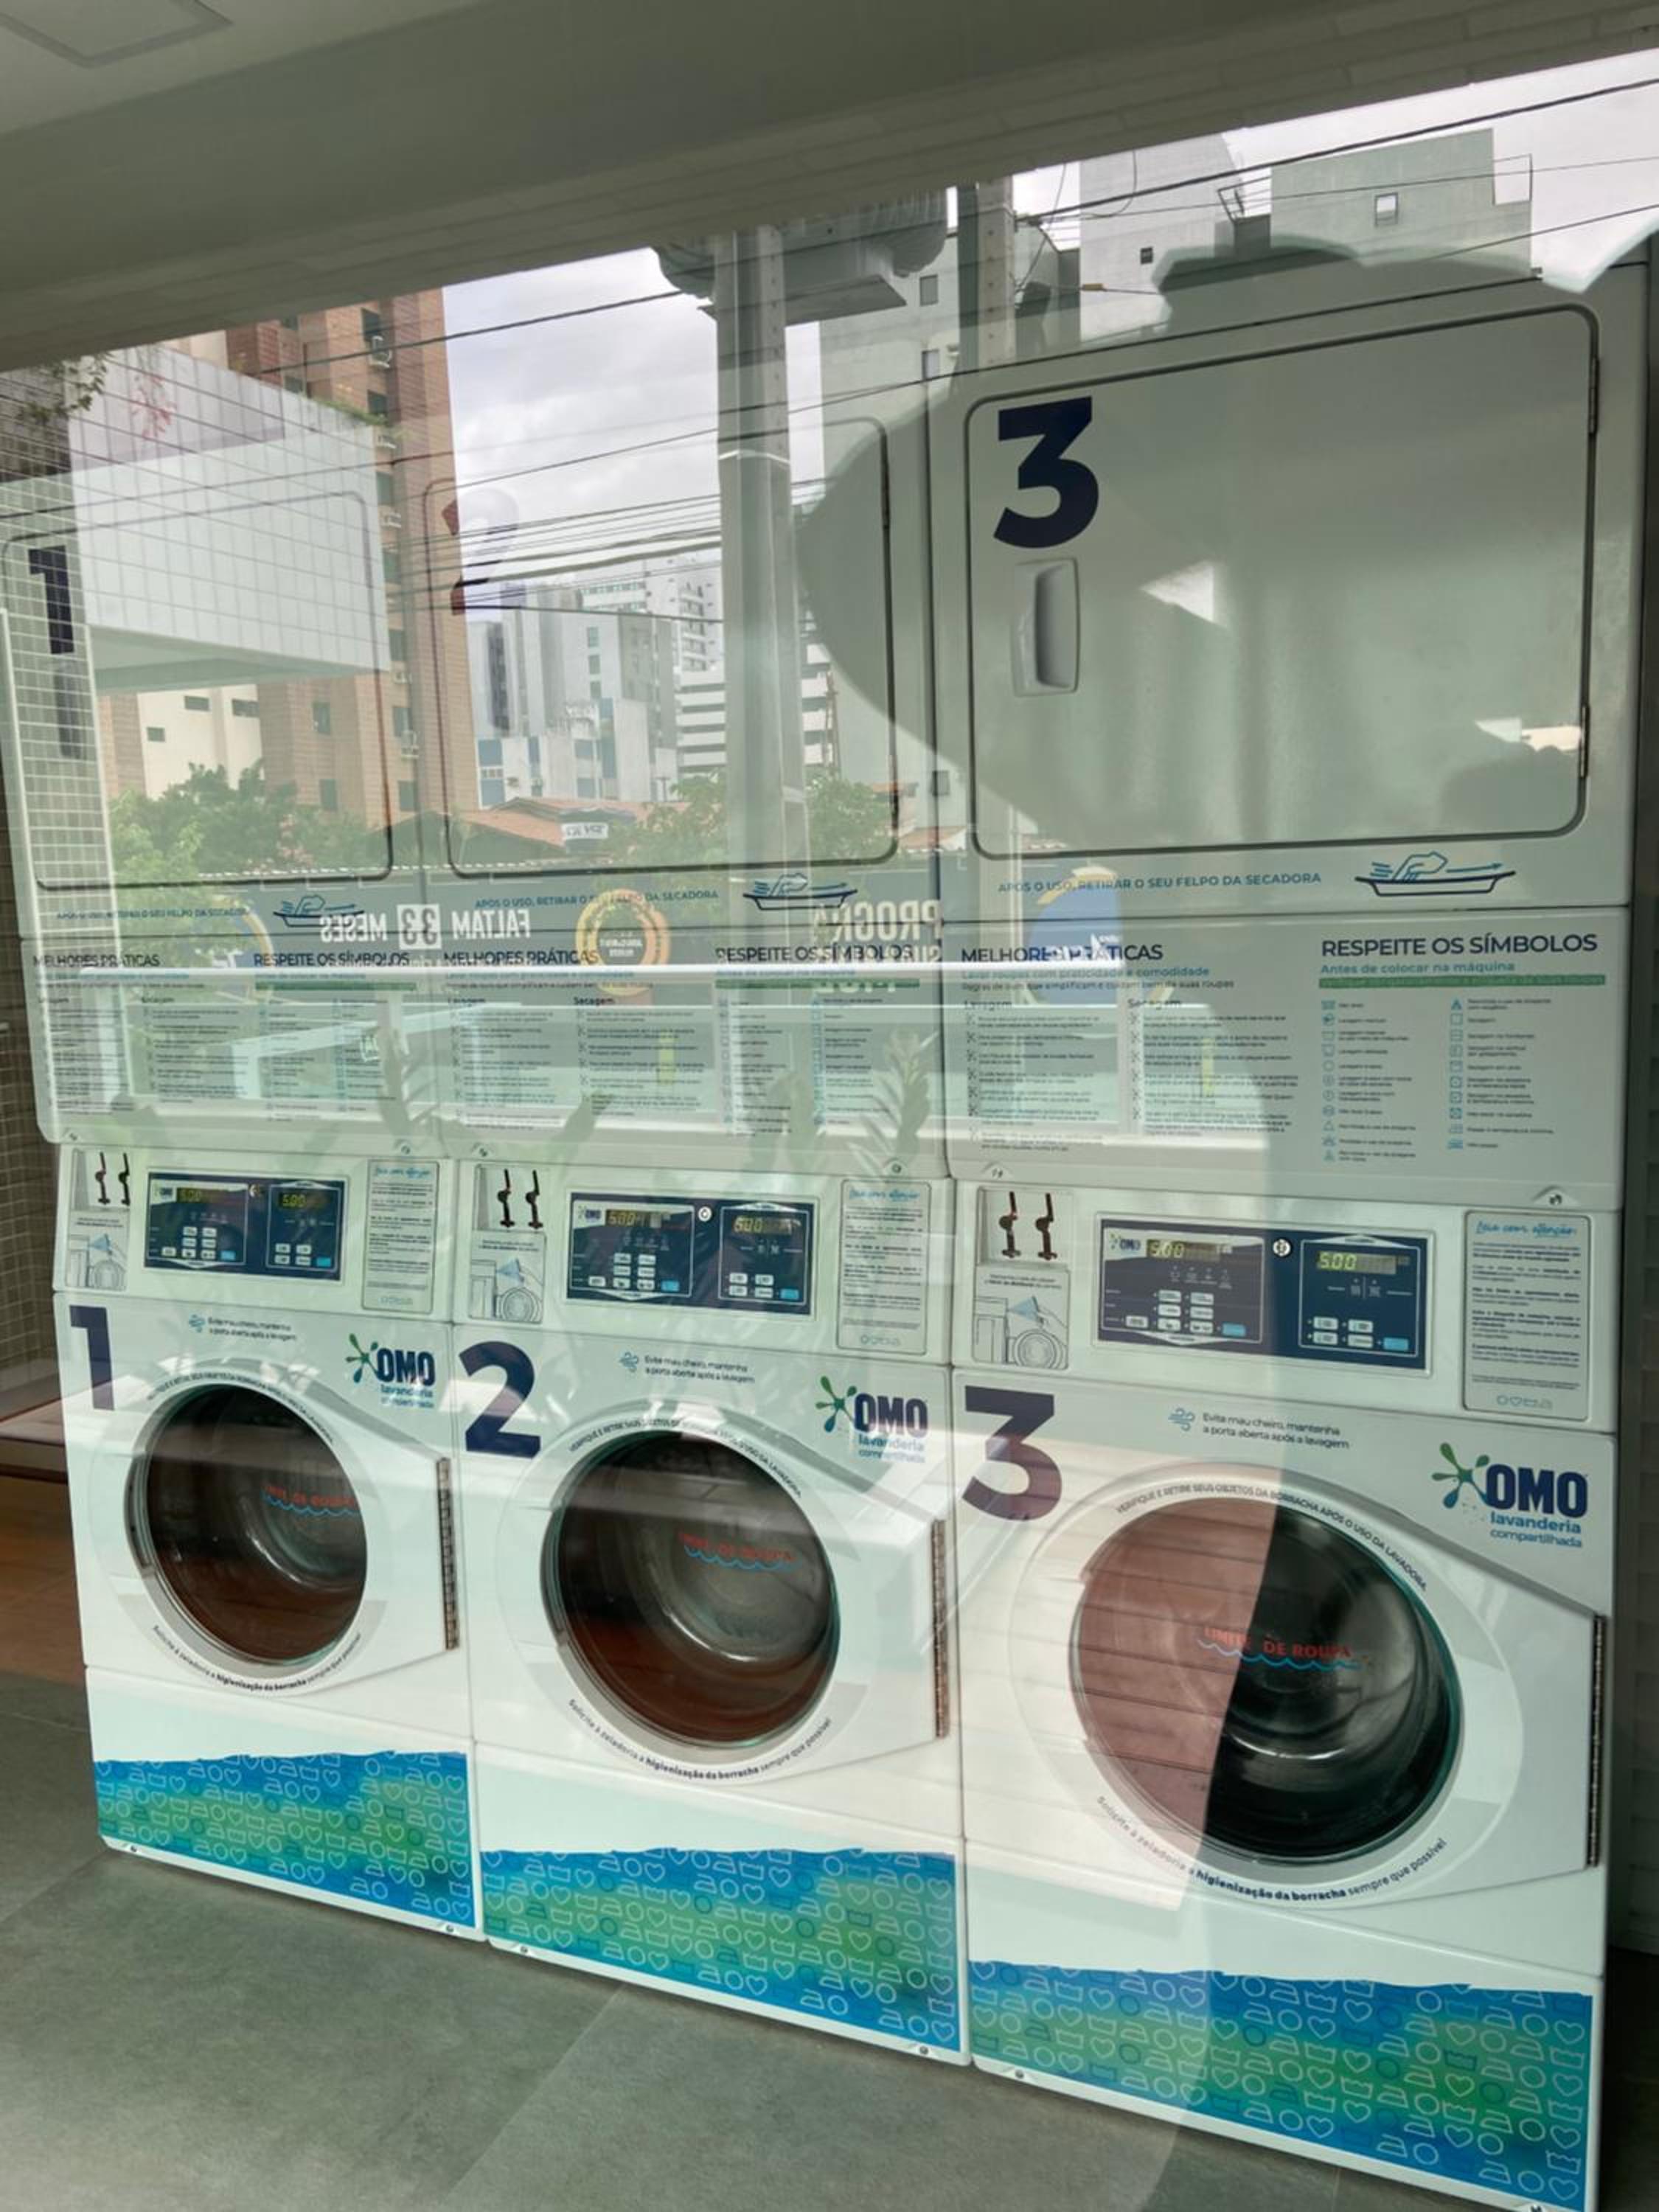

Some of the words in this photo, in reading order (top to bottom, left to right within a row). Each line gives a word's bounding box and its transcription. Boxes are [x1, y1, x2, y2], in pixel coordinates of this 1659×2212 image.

[993, 396, 1099, 549] 3
[28, 545, 74, 654] 1
[1034, 882, 1042, 891] O
[1135, 878, 1144, 888] O
[1148, 877, 1173, 888] SEU
[1176, 876, 1217, 887] FELPO
[1220, 874, 1241, 886] DA
[1245, 873, 1321, 885] SECADORA
[715, 947, 790, 962] RESPEITE
[961, 947, 1060, 963] MELHORES
[1322, 938, 1426, 957] RESPEITE
[1432, 937, 1464, 955] OS
[1470, 933, 1598, 954] SÍMBOLOS
[253, 952, 315, 967] RESPEITE
[316, 952, 336, 967] OS
[444, 951, 524, 966] MELHORES
[1321, 964, 1359, 975] Antes
[1360, 964, 1378, 974] de
[1380, 963, 1430, 974] colocar
[1433, 964, 1450, 973] na
[1453, 961, 1515, 975] máquina
[1133, 966, 1209, 977] comodidade
[69, 1304, 115, 1411] 1
[377, 1348, 436, 1387] OMO
[459, 1340, 541, 1458] 2
[854, 1392, 928, 1439] OMO
[1203, 1413, 1226, 1423] Evita
[1227, 1415, 1252, 1426] mau
[1252, 1416, 1284, 1430] cheiro,
[1285, 1422, 1341, 1436] mantenha
[1210, 1427, 1237, 1438] porta
[1238, 1429, 1270, 1440] aberta
[1271, 1432, 1296, 1444] após
[1305, 1436, 1350, 1450] lavagem
[961, 1385, 1062, 1521] 3
[1486, 1464, 1588, 1519] OMO
[1255, 1486, 1268, 1498] DA
[1321, 1506, 1345, 1524] APÓS
[1344, 1519, 1353, 1528] O
[1354, 1523, 1373, 1540] USO
[1371, 1536, 1386, 1550] DA
[1490, 1512, 1582, 1534] lavanderia
[1489, 1528, 1582, 1548] compartilhada
[1262, 1639, 1287, 1656] DE
[1292, 1643, 1352, 1659] ROUPA
[645, 1756, 705, 1780] higienização
[705, 1770, 717, 1780] da
[717, 1766, 759, 1779] borracha
[1195, 1869, 1273, 1900] higienização
[1275, 1890, 1290, 1901] da
[1290, 1888, 1347, 1902] borracha
[1347, 1875, 1391, 1896] sempre
[1389, 1866, 1411, 1883] que
[1409, 1837, 1448, 1871] possível
